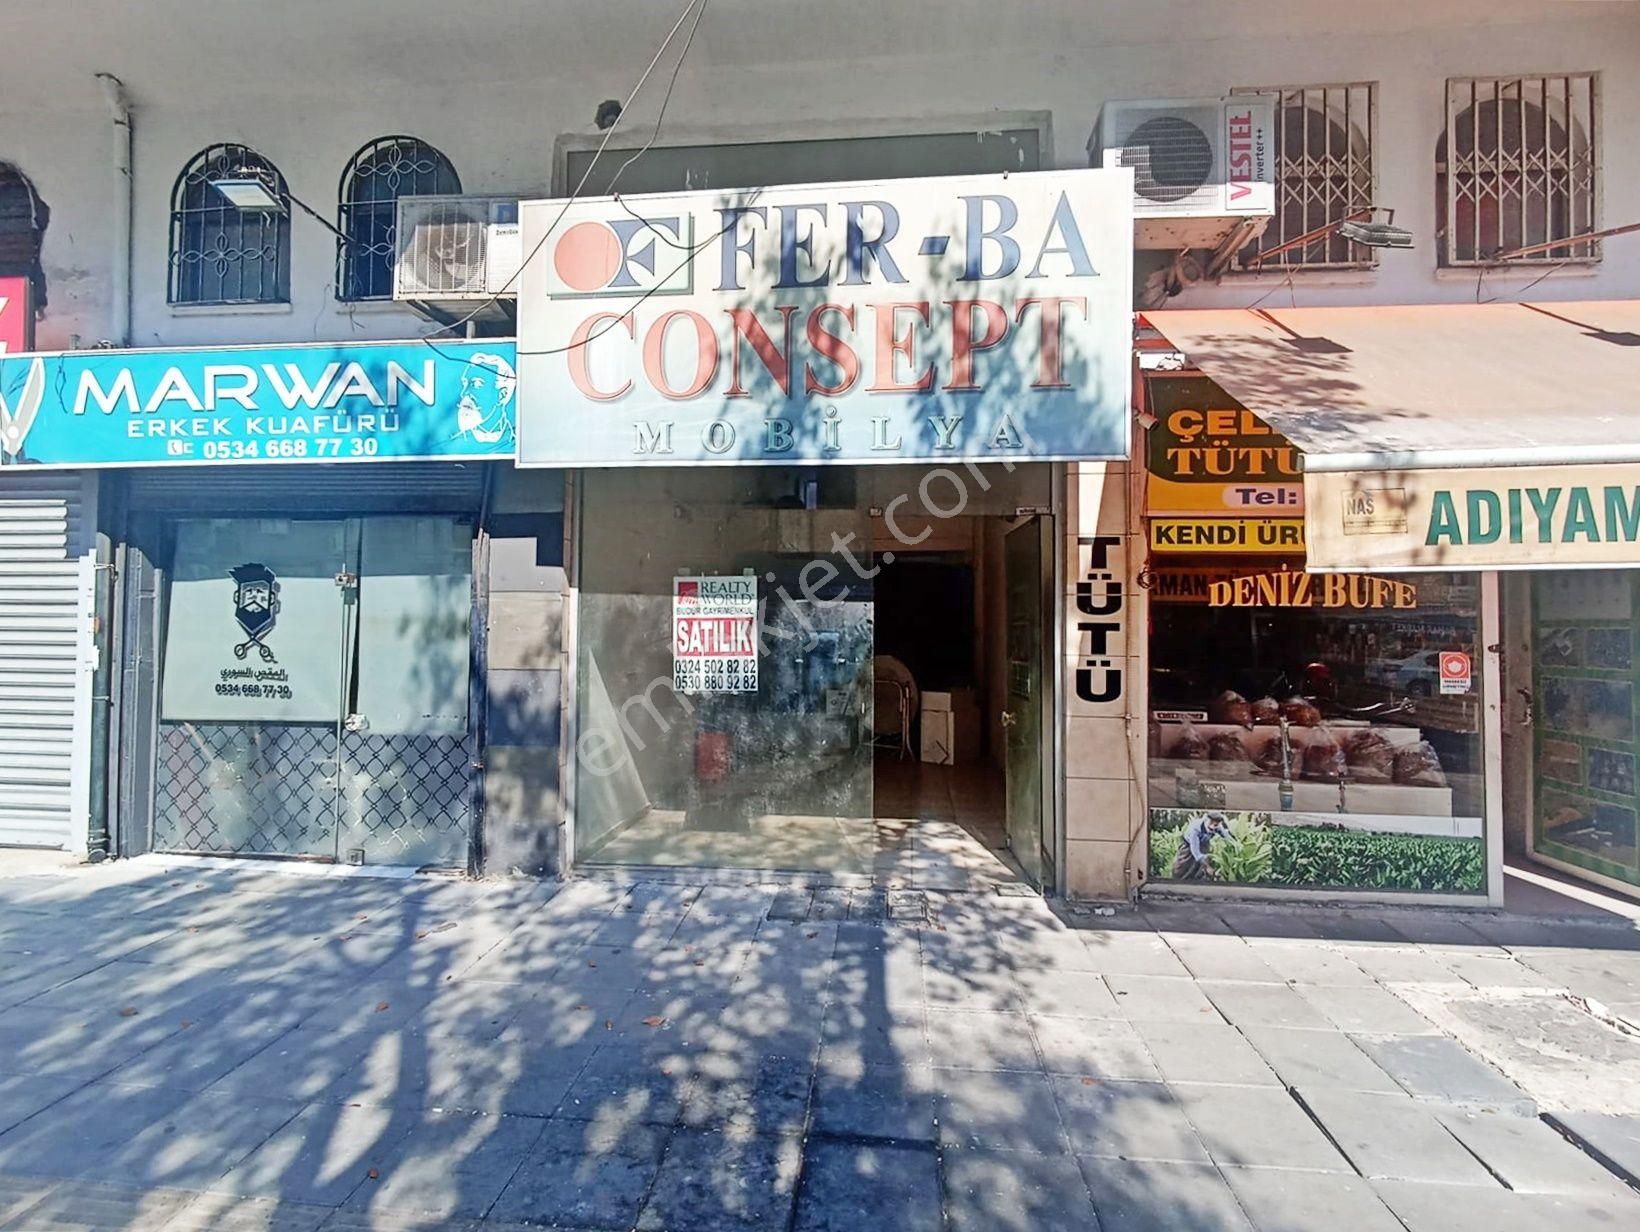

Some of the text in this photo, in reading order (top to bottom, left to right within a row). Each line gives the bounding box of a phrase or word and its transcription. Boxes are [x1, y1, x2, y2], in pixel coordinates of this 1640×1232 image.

[1229, 110, 1252, 201] VESTEL
[567, 296, 1089, 401] CONSEPT
[73, 359, 436, 415] MARWAN
[127, 407, 401, 439] ERKEK KUAFÜRÜ
[632, 406, 1024, 455] MOBİLYA
[1167, 409, 1282, 443] ÇEL
[203, 438, 379, 459] 0534 668 77 30
[1235, 488, 1297, 505] Tel:
[1155, 520, 1305, 545] KENDİ ÜR
[1424, 486, 1640, 546] ADIYAM
[700, 593, 753, 605] WORLD
[701, 581, 752, 593] REALTY
[1208, 563, 1313, 608] DENİZ
[677, 619, 751, 654] SATILIK
[1076, 537, 1122, 703] TÜTÜ
[675, 660, 756, 674] 0324 502 82 82
[675, 675, 756, 690] 0530 880 92 82
[215, 684, 290, 695] 0534 668 77 30
